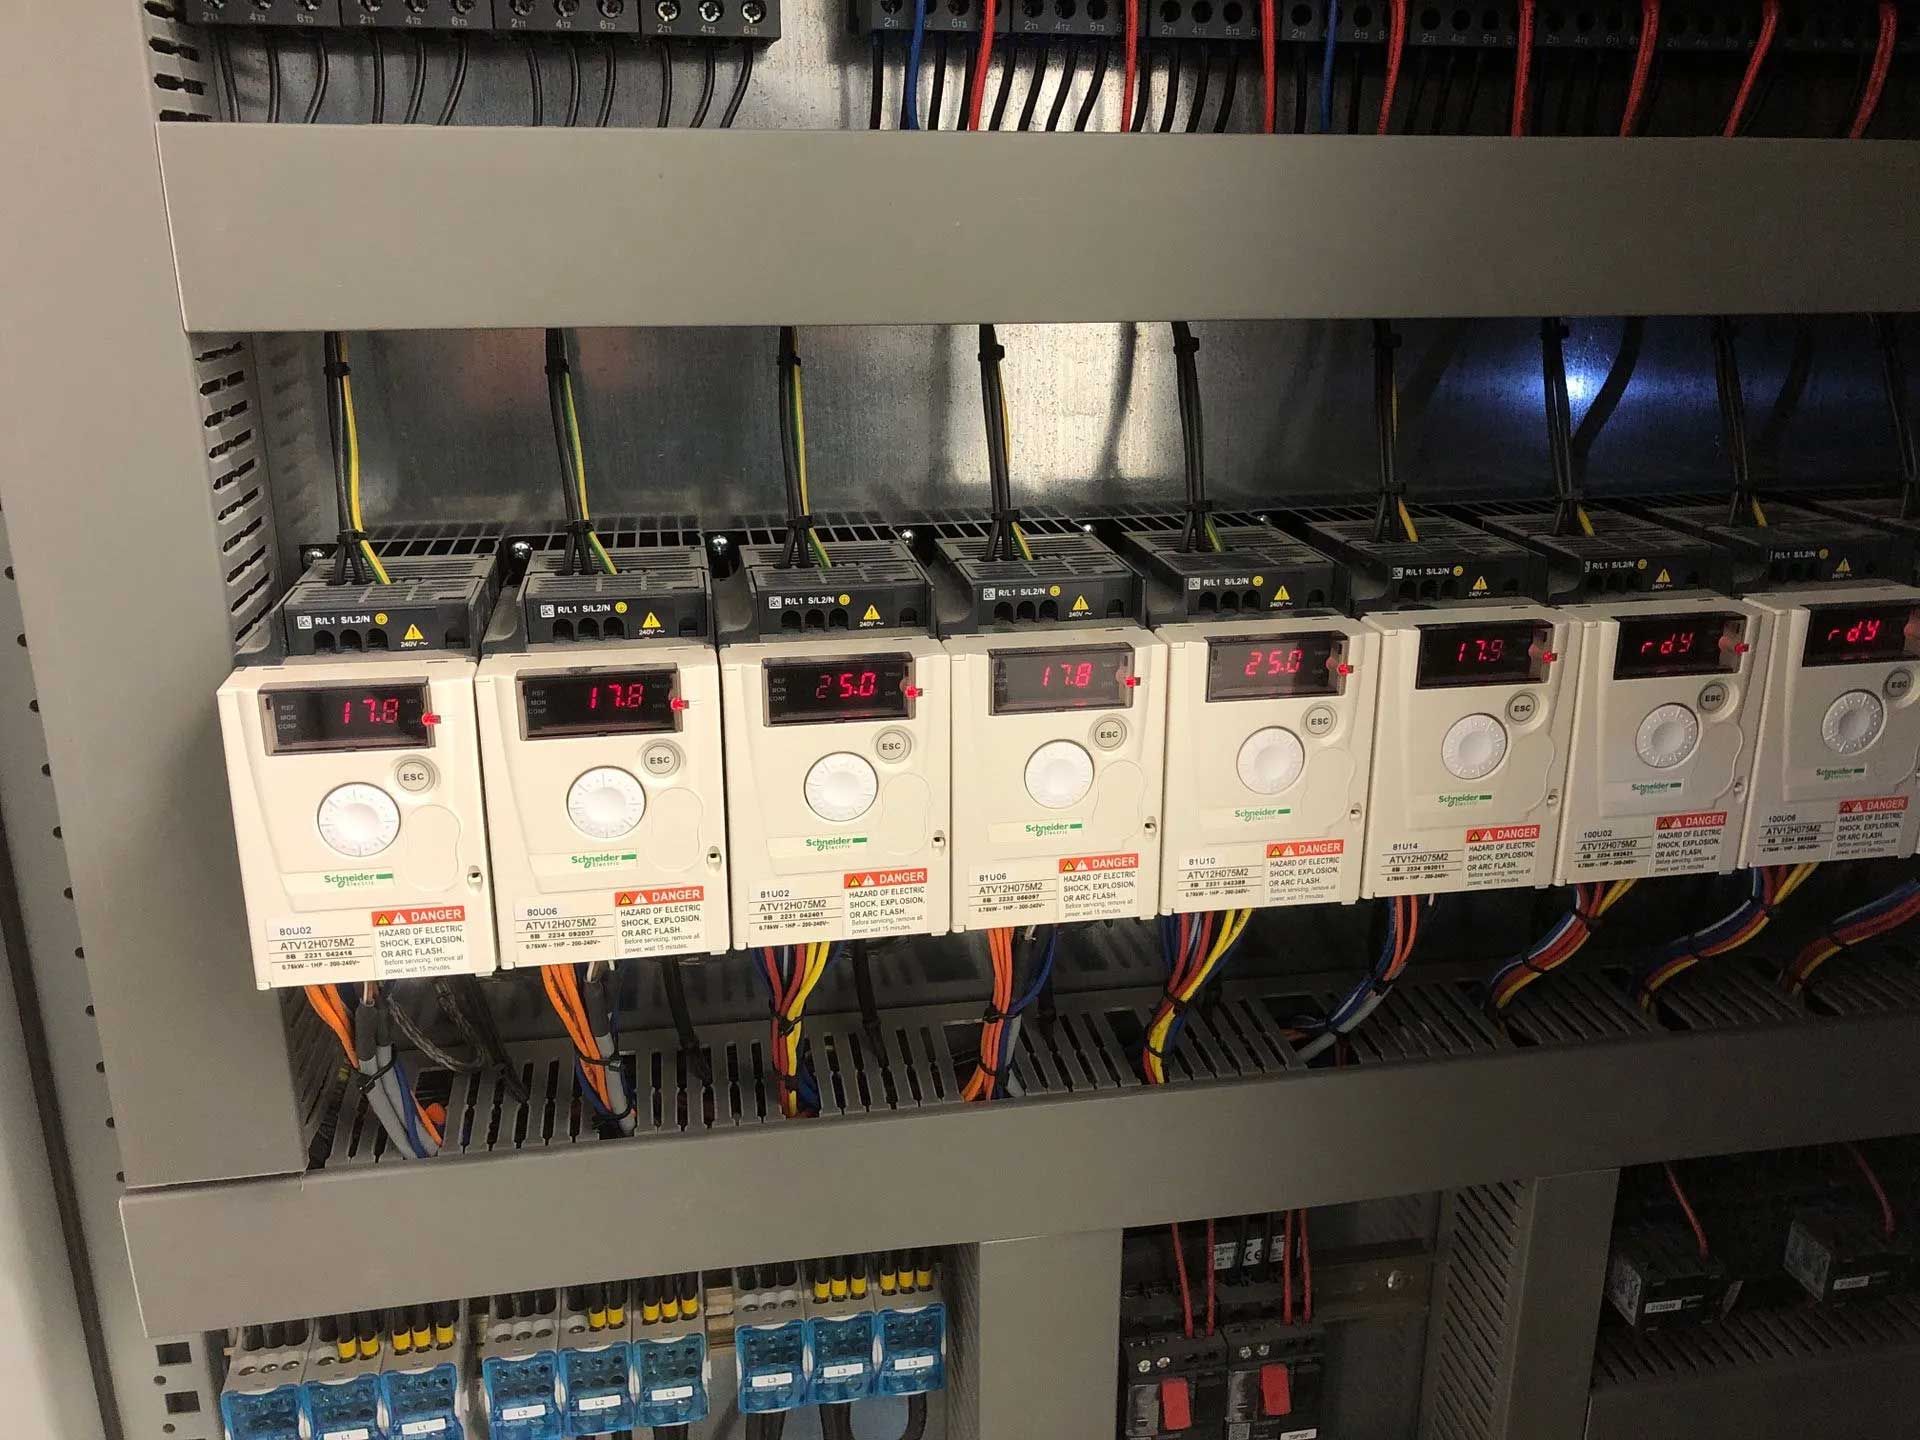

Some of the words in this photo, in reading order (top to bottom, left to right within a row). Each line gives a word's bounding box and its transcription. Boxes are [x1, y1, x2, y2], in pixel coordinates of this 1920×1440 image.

[1406, 568, 1422, 576] R/L1
[1426, 567, 1450, 576] S/L2/N
[1203, 579, 1220, 587] R/L1
[1224, 577, 1249, 586] S/L2/N
[998, 589, 1016, 597] R/L1
[1020, 587, 1046, 596] S/L2/N
[784, 597, 803, 606] R/L1
[807, 596, 835, 605] S/L2/N
[557, 605, 577, 614] R/L1
[582, 604, 611, 613] S/L2/N
[314, 616, 336, 625] R/L1
[340, 615, 370, 624] S/L2/N
[1244, 649, 1304, 676] 25.0
[1041, 662, 1093, 688] 17.8
[815, 671, 876, 699] 25.0
[589, 683, 644, 709] 17.8
[342, 698, 399, 724] 17.8
[1513, 704, 1532, 713] ESC
[1311, 717, 1330, 726] ESC
[1100, 730, 1119, 739] ESC
[881, 742, 901, 751] ESC
[649, 756, 670, 765] ESC
[402, 772, 425, 781] ESC
[1438, 792, 1479, 804] Schneider
[1866, 797, 1906, 810] DANGER
[1234, 806, 1277, 818] Schneider
[1684, 813, 1725, 827] DANGER
[1025, 821, 1068, 833] Schneider
[1496, 826, 1538, 839] DANGER
[1582, 829, 1613, 839] 100U02
[1656, 830, 1683, 840] HAZARD
[1682, 830, 1692, 838] OF
[1691, 827, 1722, 837] ELECTRIC
[804, 835, 852, 847] Schneider
[1391, 841, 1418, 851] 81U14
[1467, 843, 1495, 853] HAZARD
[1494, 842, 1505, 851] OF
[1504, 840, 1536, 850] ELECTRIC
[1298, 841, 1341, 855] DANGER
[1653, 850, 1665, 859] OR
[1664, 849, 1680, 858] ARC
[570, 852, 621, 865] Schneider
[1092, 855, 1136, 869] DANGER
[1188, 856, 1216, 866] 81U10
[1269, 858, 1297, 868] HAZARD
[1297, 858, 1307, 867] OF
[1307, 855, 1340, 866] ELECTRIC
[1388, 852, 1449, 865] ATV12H075M2
[1465, 863, 1477, 872] OR
[1476, 862, 1492, 871] ARC
[323, 871, 376, 884] Schneider
[878, 870, 925, 884] DANGER
[978, 872, 1007, 882] 81U06
[1062, 873, 1091, 883] HAZARD
[1091, 872, 1102, 881] OF
[1101, 869, 1136, 880] ELECTRIC
[1186, 867, 1250, 880] ATV12H075M2
[978, 881, 1043, 895] ATV12H075M2
[1268, 878, 1280, 888] OR
[1279, 877, 1296, 887] ARC
[651, 888, 701, 902] DANGER
[759, 888, 790, 899] 81U02
[848, 889, 879, 899] HAZARD
[878, 888, 890, 897] OF
[890, 885, 925, 896] ELECTRIC
[1061, 893, 1074, 903] OR
[1074, 892, 1090, 902] ARC
[618, 907, 652, 918] HAZARD
[651, 906, 664, 915] OF
[663, 903, 702, 914] ELECTRIC
[757, 898, 828, 913] ATV12H075M2
[409, 907, 463, 923] DANGER
[525, 906, 558, 918] 80U06
[848, 910, 862, 919] OR
[861, 908, 879, 918] ARC
[523, 916, 598, 931] ATV12H075M2
[277, 925, 313, 936] 80U02
[377, 927, 412, 938] HAZARD
[411, 926, 424, 936] OF
[423, 923, 464, 934] ELECTRIC
[620, 928, 634, 938] OR
[633, 927, 653, 937] ARC
[278, 936, 356, 952] ATV12H075M2
[379, 949, 395, 959] OR
[394, 947, 414, 958] ARC
